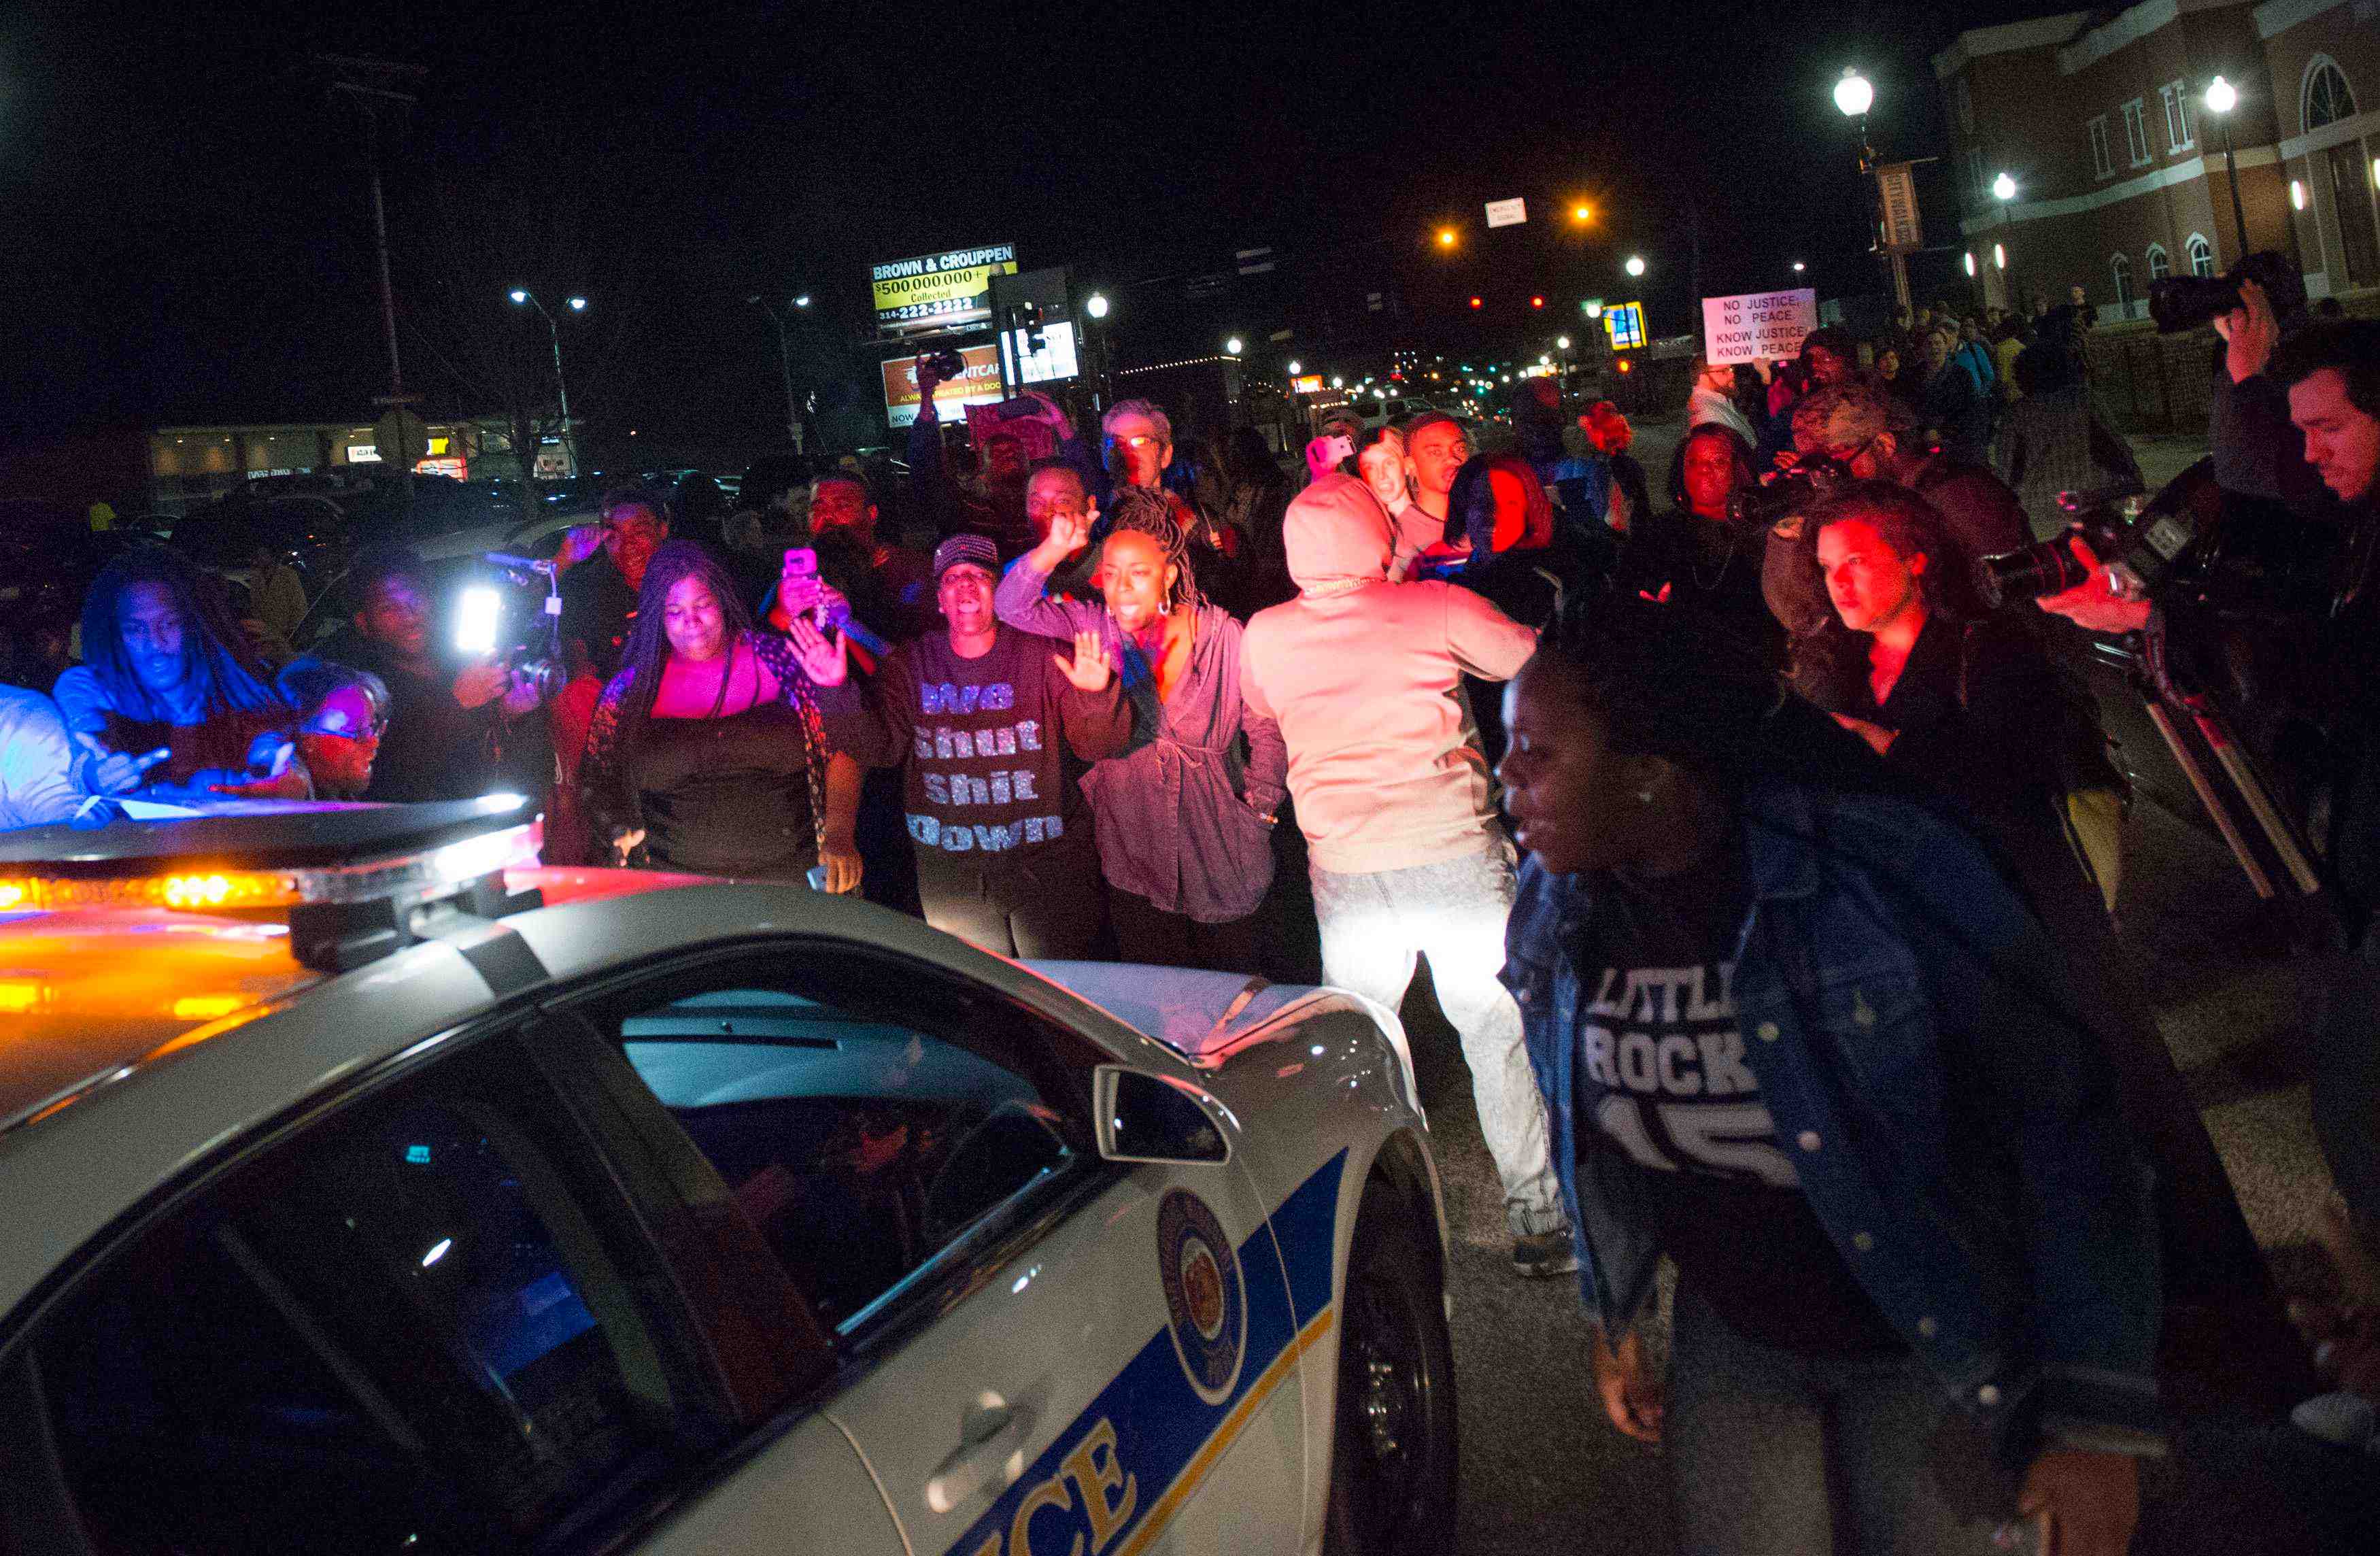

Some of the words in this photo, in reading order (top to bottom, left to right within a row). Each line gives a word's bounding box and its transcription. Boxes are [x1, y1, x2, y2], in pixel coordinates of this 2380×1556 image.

[873, 260, 923, 280] BROWN
[925, 258, 938, 272] &
[939, 246, 1013, 271] CROUPPEN
[911, 289, 952, 303] Collected
[1724, 300, 1741, 311] NO
[1725, 314, 1741, 325] NO
[1717, 331, 1752, 343] KNOW
[1718, 345, 1752, 358] KNOW
[977, 384, 984, 392] A
[892, 413, 915, 423] NOW
[1584, 1024, 1758, 1094] ROCK
